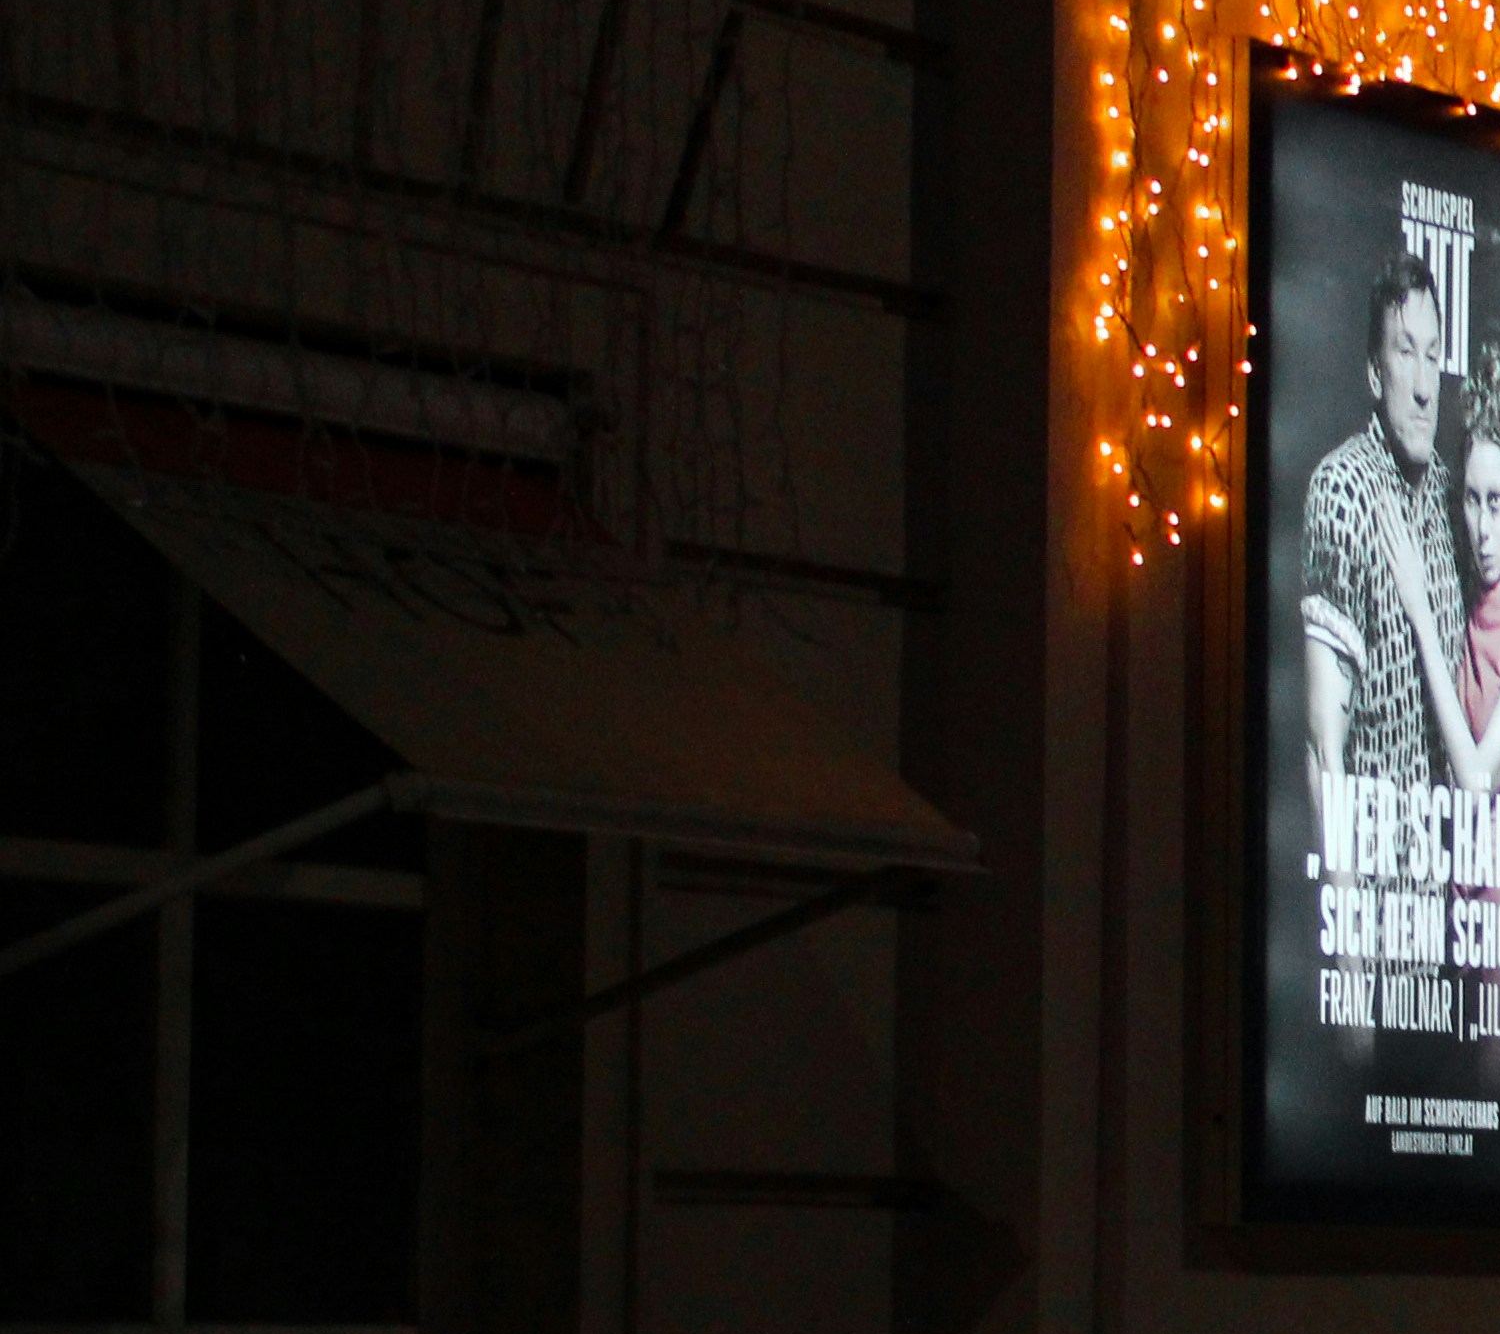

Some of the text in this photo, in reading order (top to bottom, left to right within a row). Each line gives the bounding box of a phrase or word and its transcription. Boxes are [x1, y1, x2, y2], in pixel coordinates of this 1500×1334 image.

[1401, 180, 1475, 235] SCHAUSPIEL
[1320, 883, 1377, 958] SICH
[1384, 891, 1446, 965] DENN
[1319, 968, 1377, 1029] FRANZ
[1365, 1094, 1500, 1130] AUF BALD IM SCHAUSPIELHAUS
